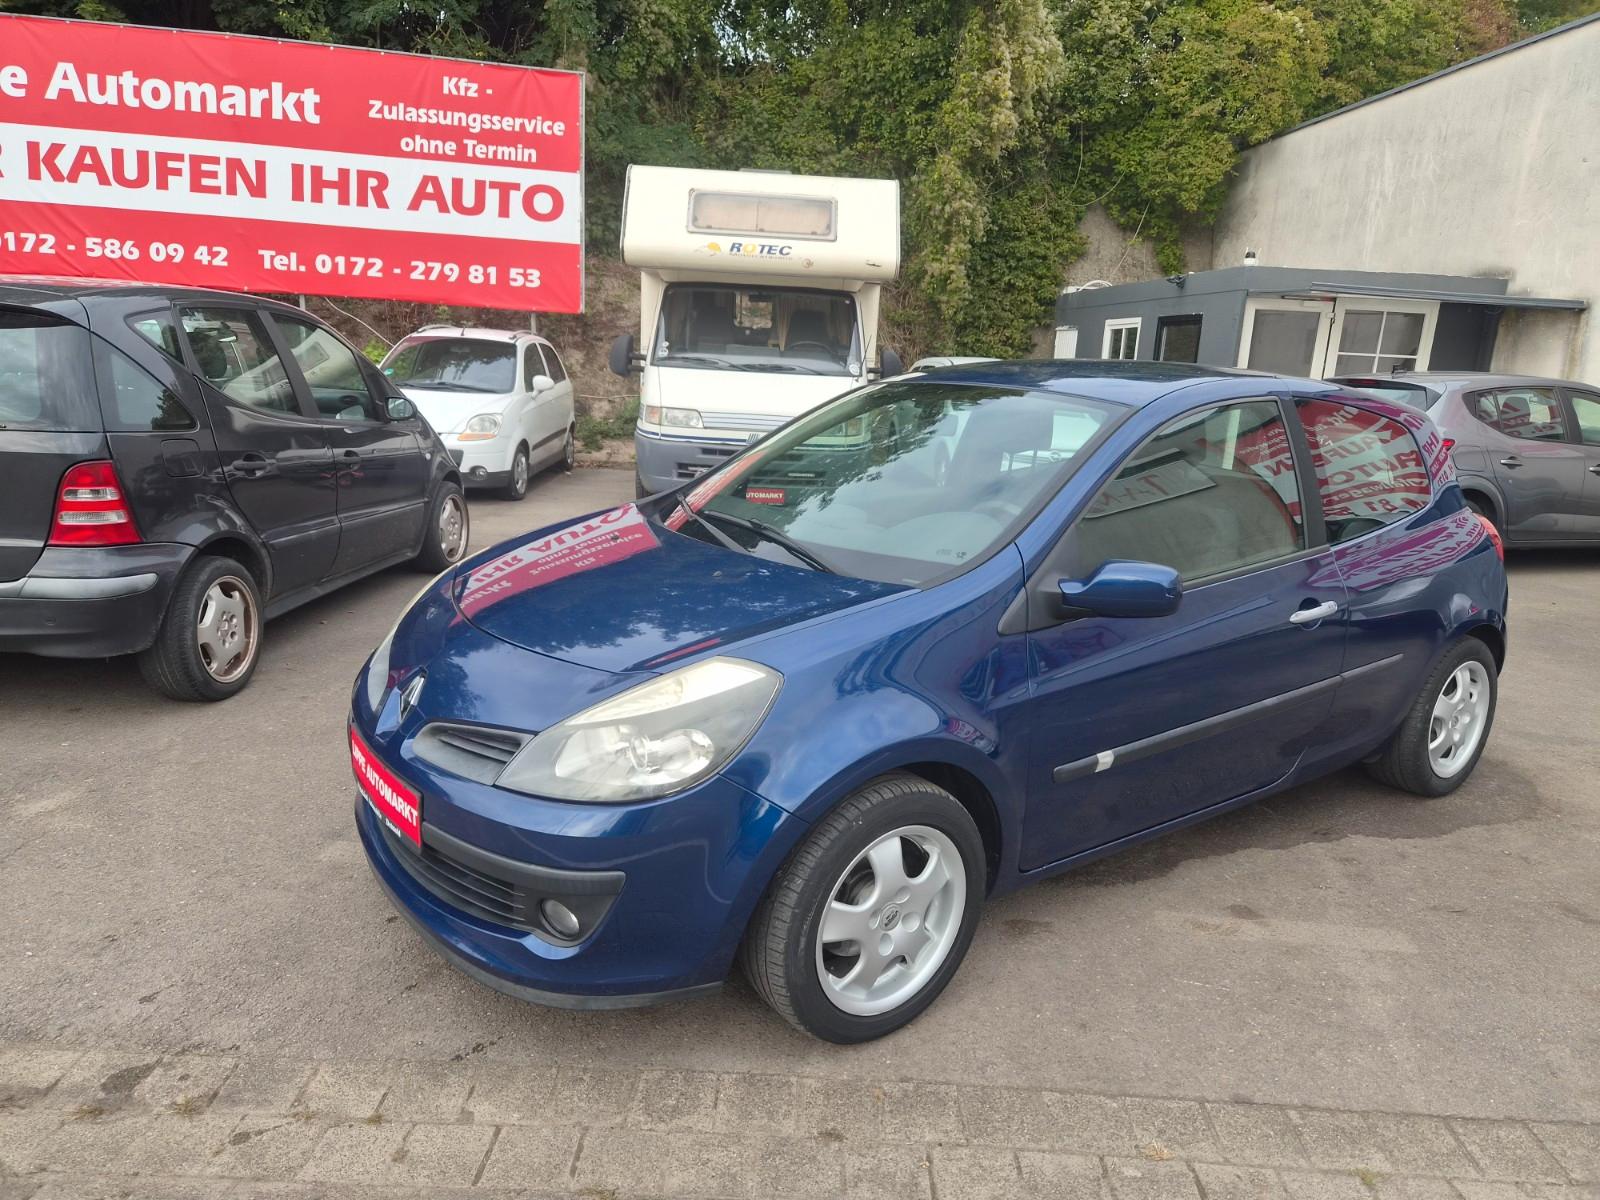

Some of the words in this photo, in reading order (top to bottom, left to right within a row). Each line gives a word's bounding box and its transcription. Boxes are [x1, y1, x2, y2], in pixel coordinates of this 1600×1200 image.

[44, 61, 321, 125] Automarkt
[442, 76, 479, 98] Kfz
[368, 99, 566, 136] Zulassungsservice
[400, 134, 457, 156] ohne
[463, 139, 537, 163] Termin
[26, 140, 267, 199] KAUFEN
[291, 163, 390, 210] IHR
[407, 174, 564, 222] AUTO
[0, 231, 56, 254] 172
[85, 237, 140, 260] 586
[149, 241, 185, 263] 09
[194, 245, 228, 267] 42
[729, 242, 793, 256] ROTEC
[258, 249, 306, 272] Tel.
[315, 254, 383, 278] 0172
[410, 260, 460, 282] 279
[468, 264, 497, 285] 81
[509, 267, 541, 288] 53
[366, 763, 419, 827] AUTOMARKT
